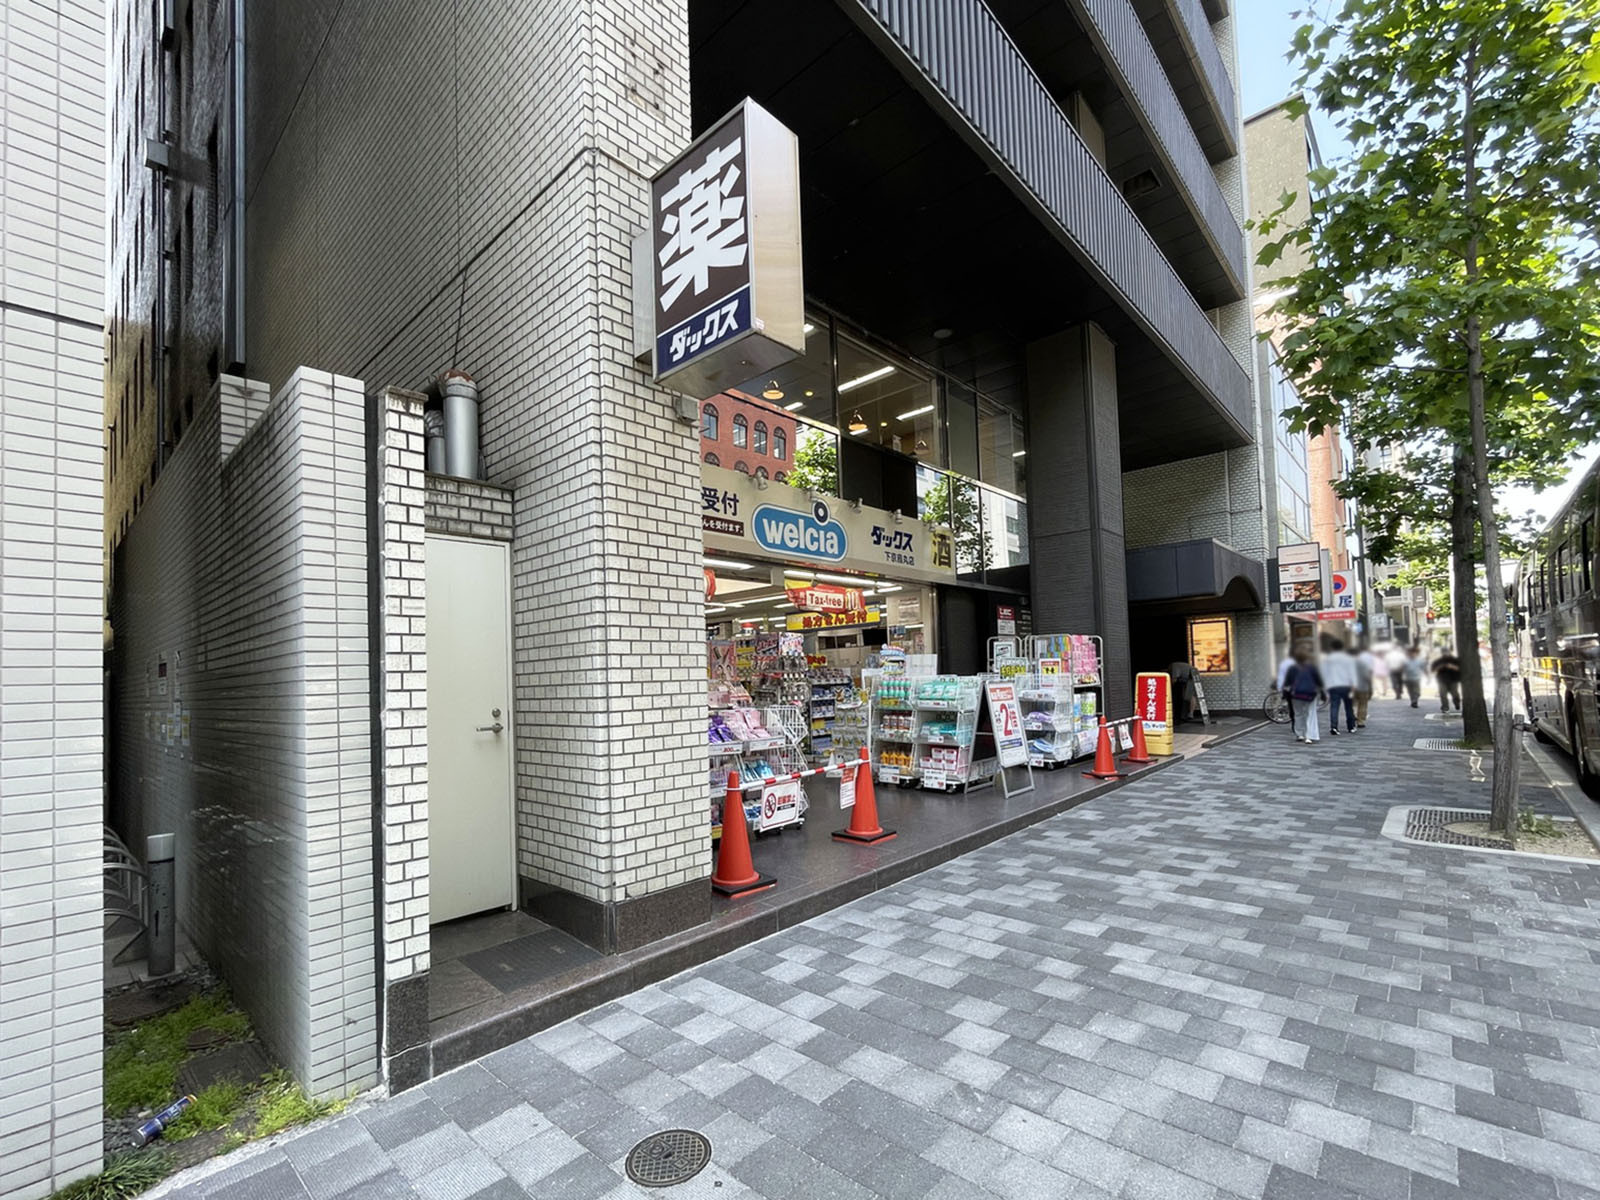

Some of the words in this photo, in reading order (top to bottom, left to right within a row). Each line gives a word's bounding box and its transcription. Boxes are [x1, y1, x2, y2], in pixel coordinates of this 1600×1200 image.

[659, 136, 748, 313] 薬
[669, 298, 741, 363] ダックス
[700, 486, 739, 517] 受付
[762, 518, 839, 555] welcia
[870, 525, 914, 553] ダックス
[931, 532, 952, 569] 酒
[808, 592, 842, 607] Tax-free
